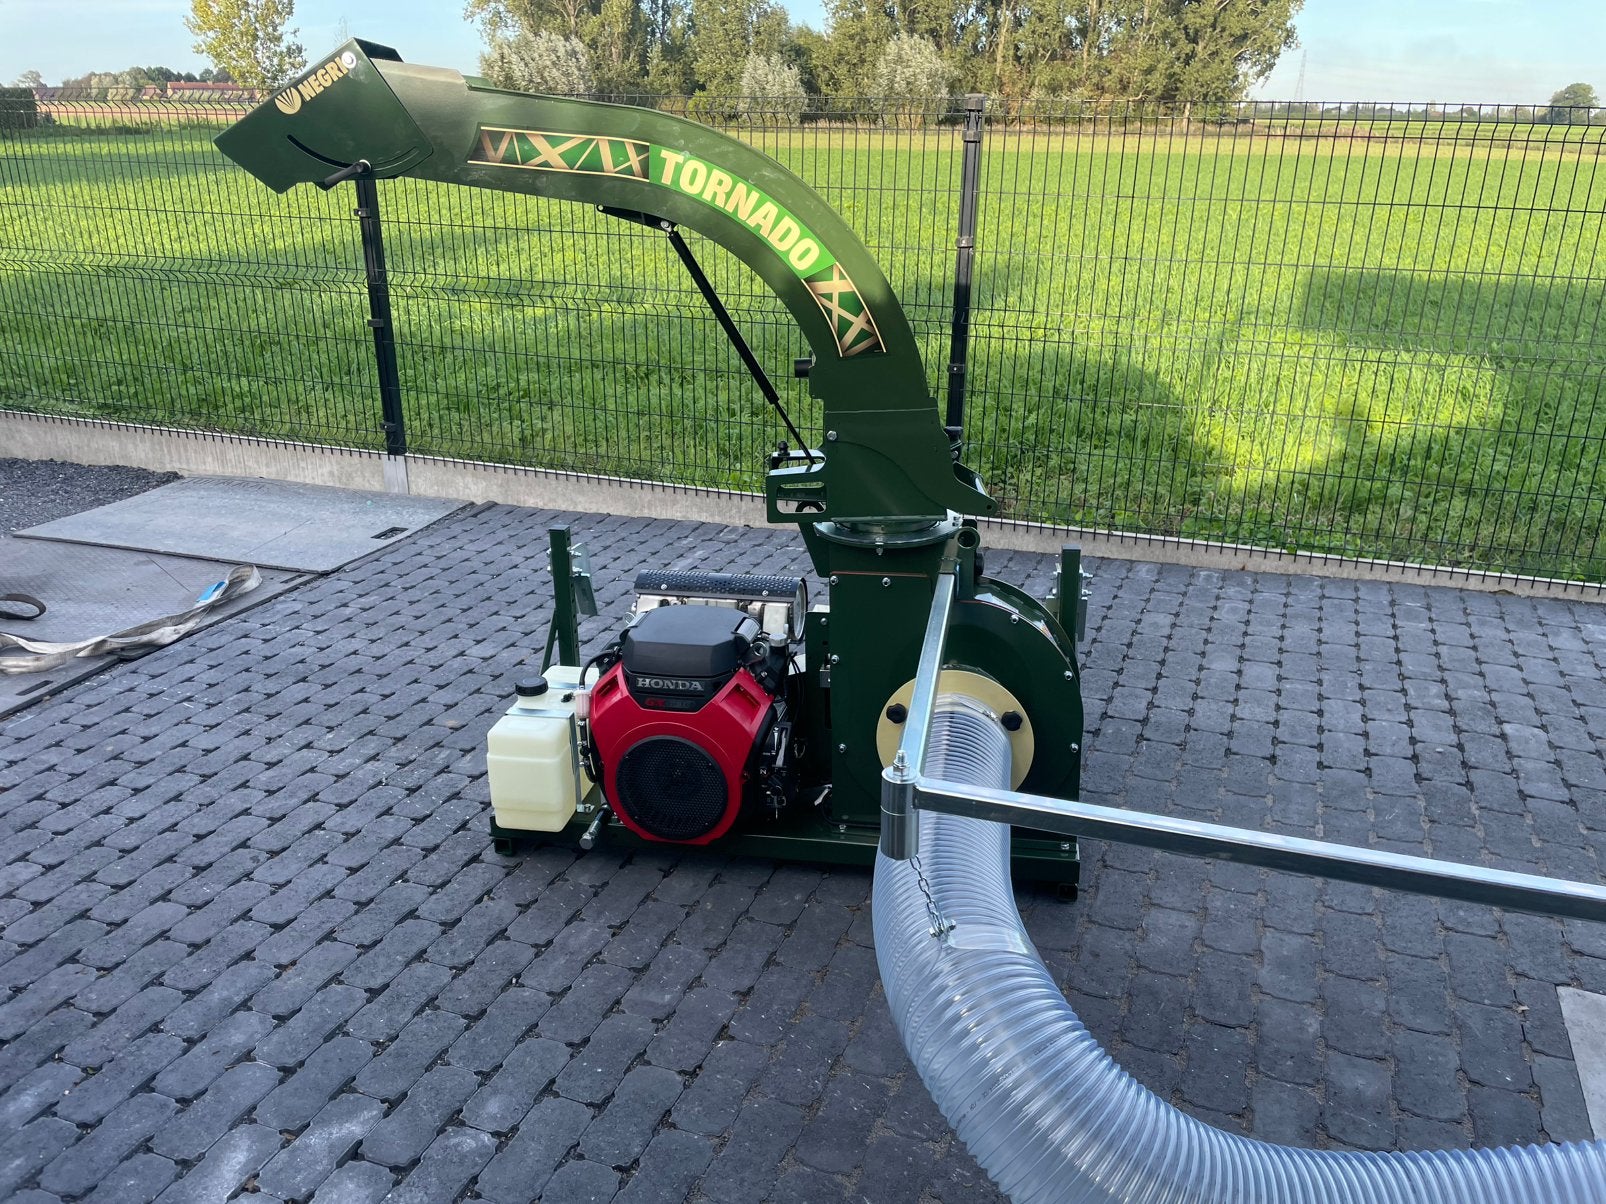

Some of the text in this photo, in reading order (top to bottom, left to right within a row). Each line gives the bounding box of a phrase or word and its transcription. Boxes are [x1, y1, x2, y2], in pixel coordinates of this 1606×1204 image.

[297, 56, 349, 102] NEGRI
[660, 150, 820, 271] TORNADO
[636, 677, 705, 691] HONDA
